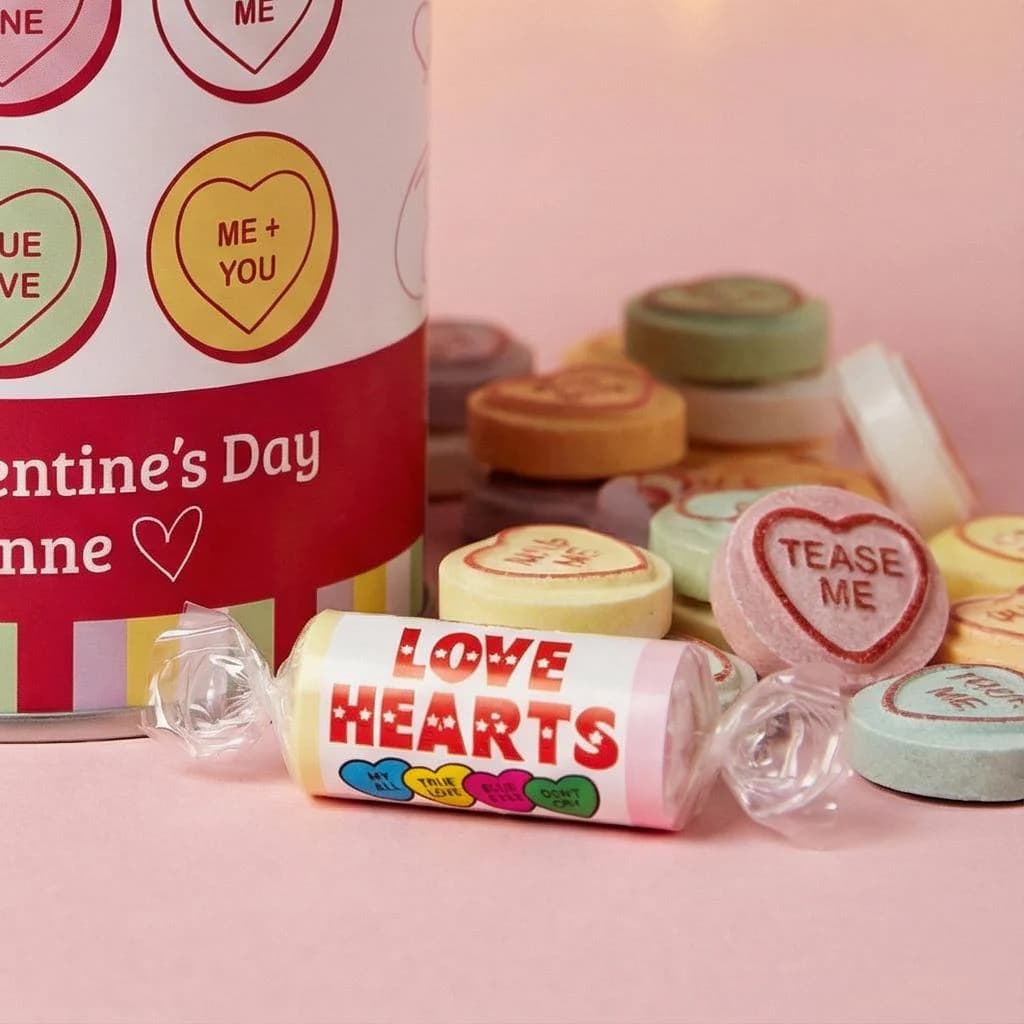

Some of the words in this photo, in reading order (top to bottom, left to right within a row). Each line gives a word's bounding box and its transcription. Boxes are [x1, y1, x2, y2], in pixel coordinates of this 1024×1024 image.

[217, 218, 257, 247] ME
[219, 254, 277, 286] YOU
[222, 429, 320, 484] Day
[778, 537, 905, 578] TEASE
[819, 575, 877, 612] ME
[392, 627, 573, 692] LOVE
[329, 683, 619, 770] HEARTS
